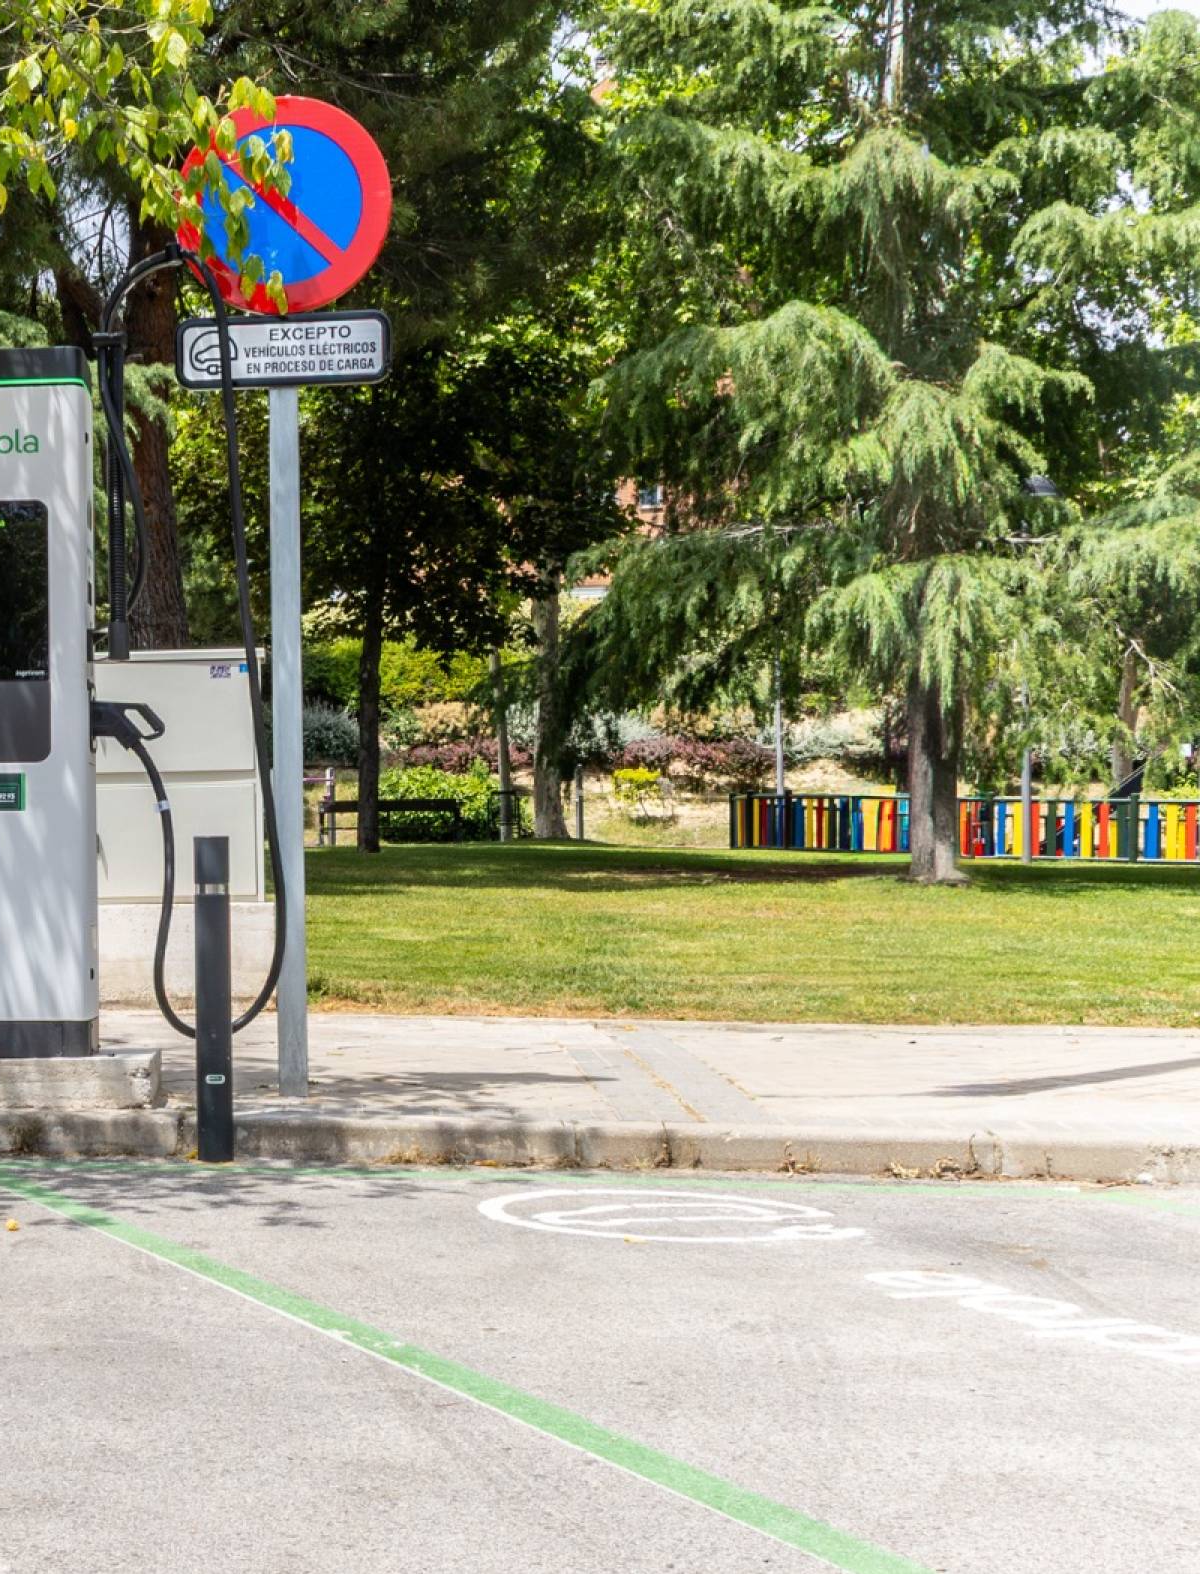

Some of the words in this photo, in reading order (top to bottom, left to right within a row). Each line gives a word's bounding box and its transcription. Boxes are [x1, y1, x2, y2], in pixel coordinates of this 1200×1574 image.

[269, 325, 352, 341] EXCEPTO
[243, 343, 306, 358] VEHÍCULOS
[308, 341, 377, 357] ELÉCTRICOS
[246, 363, 261, 374] EN
[264, 360, 316, 373] PROCESO
[319, 359, 334, 371] DE
[337, 357, 375, 370] CARGA
